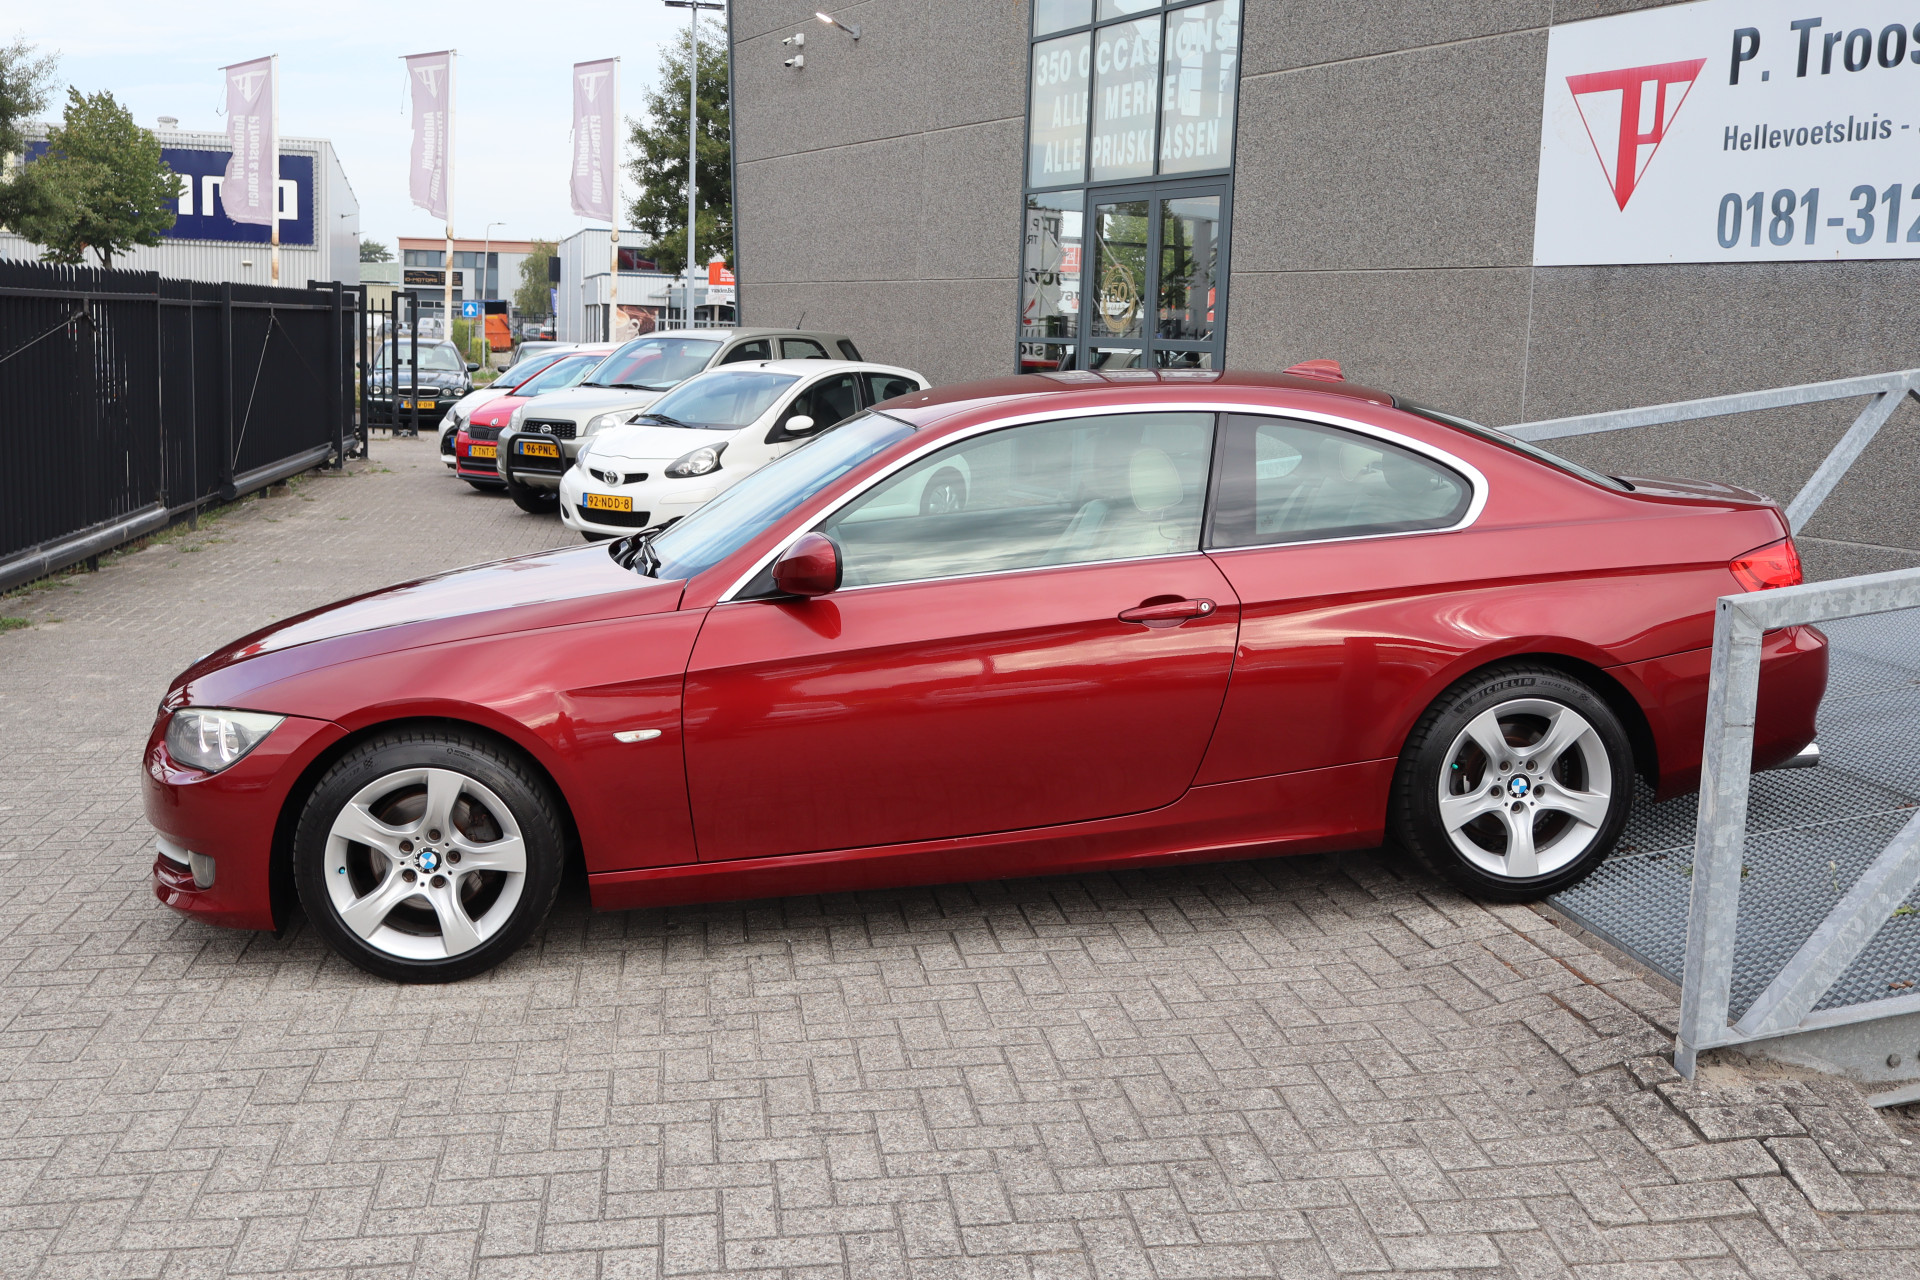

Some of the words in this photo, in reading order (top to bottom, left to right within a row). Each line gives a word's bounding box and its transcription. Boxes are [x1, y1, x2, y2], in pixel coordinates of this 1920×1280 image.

[1037, 50, 1071, 87] 350
[1078, 14, 1231, 79] OCCASIONS
[1728, 27, 1770, 86] P.
[1052, 91, 1089, 128] ALLE
[1105, 71, 1192, 121] MERKEN
[1723, 112, 1892, 151] Hellevoetsluis
[1044, 137, 1081, 174] ALLE
[1110, 282, 1128, 302] 50
[588, 496, 630, 510] 92-NDD-8
[1470, 678, 1534, 701] MICHELIN
